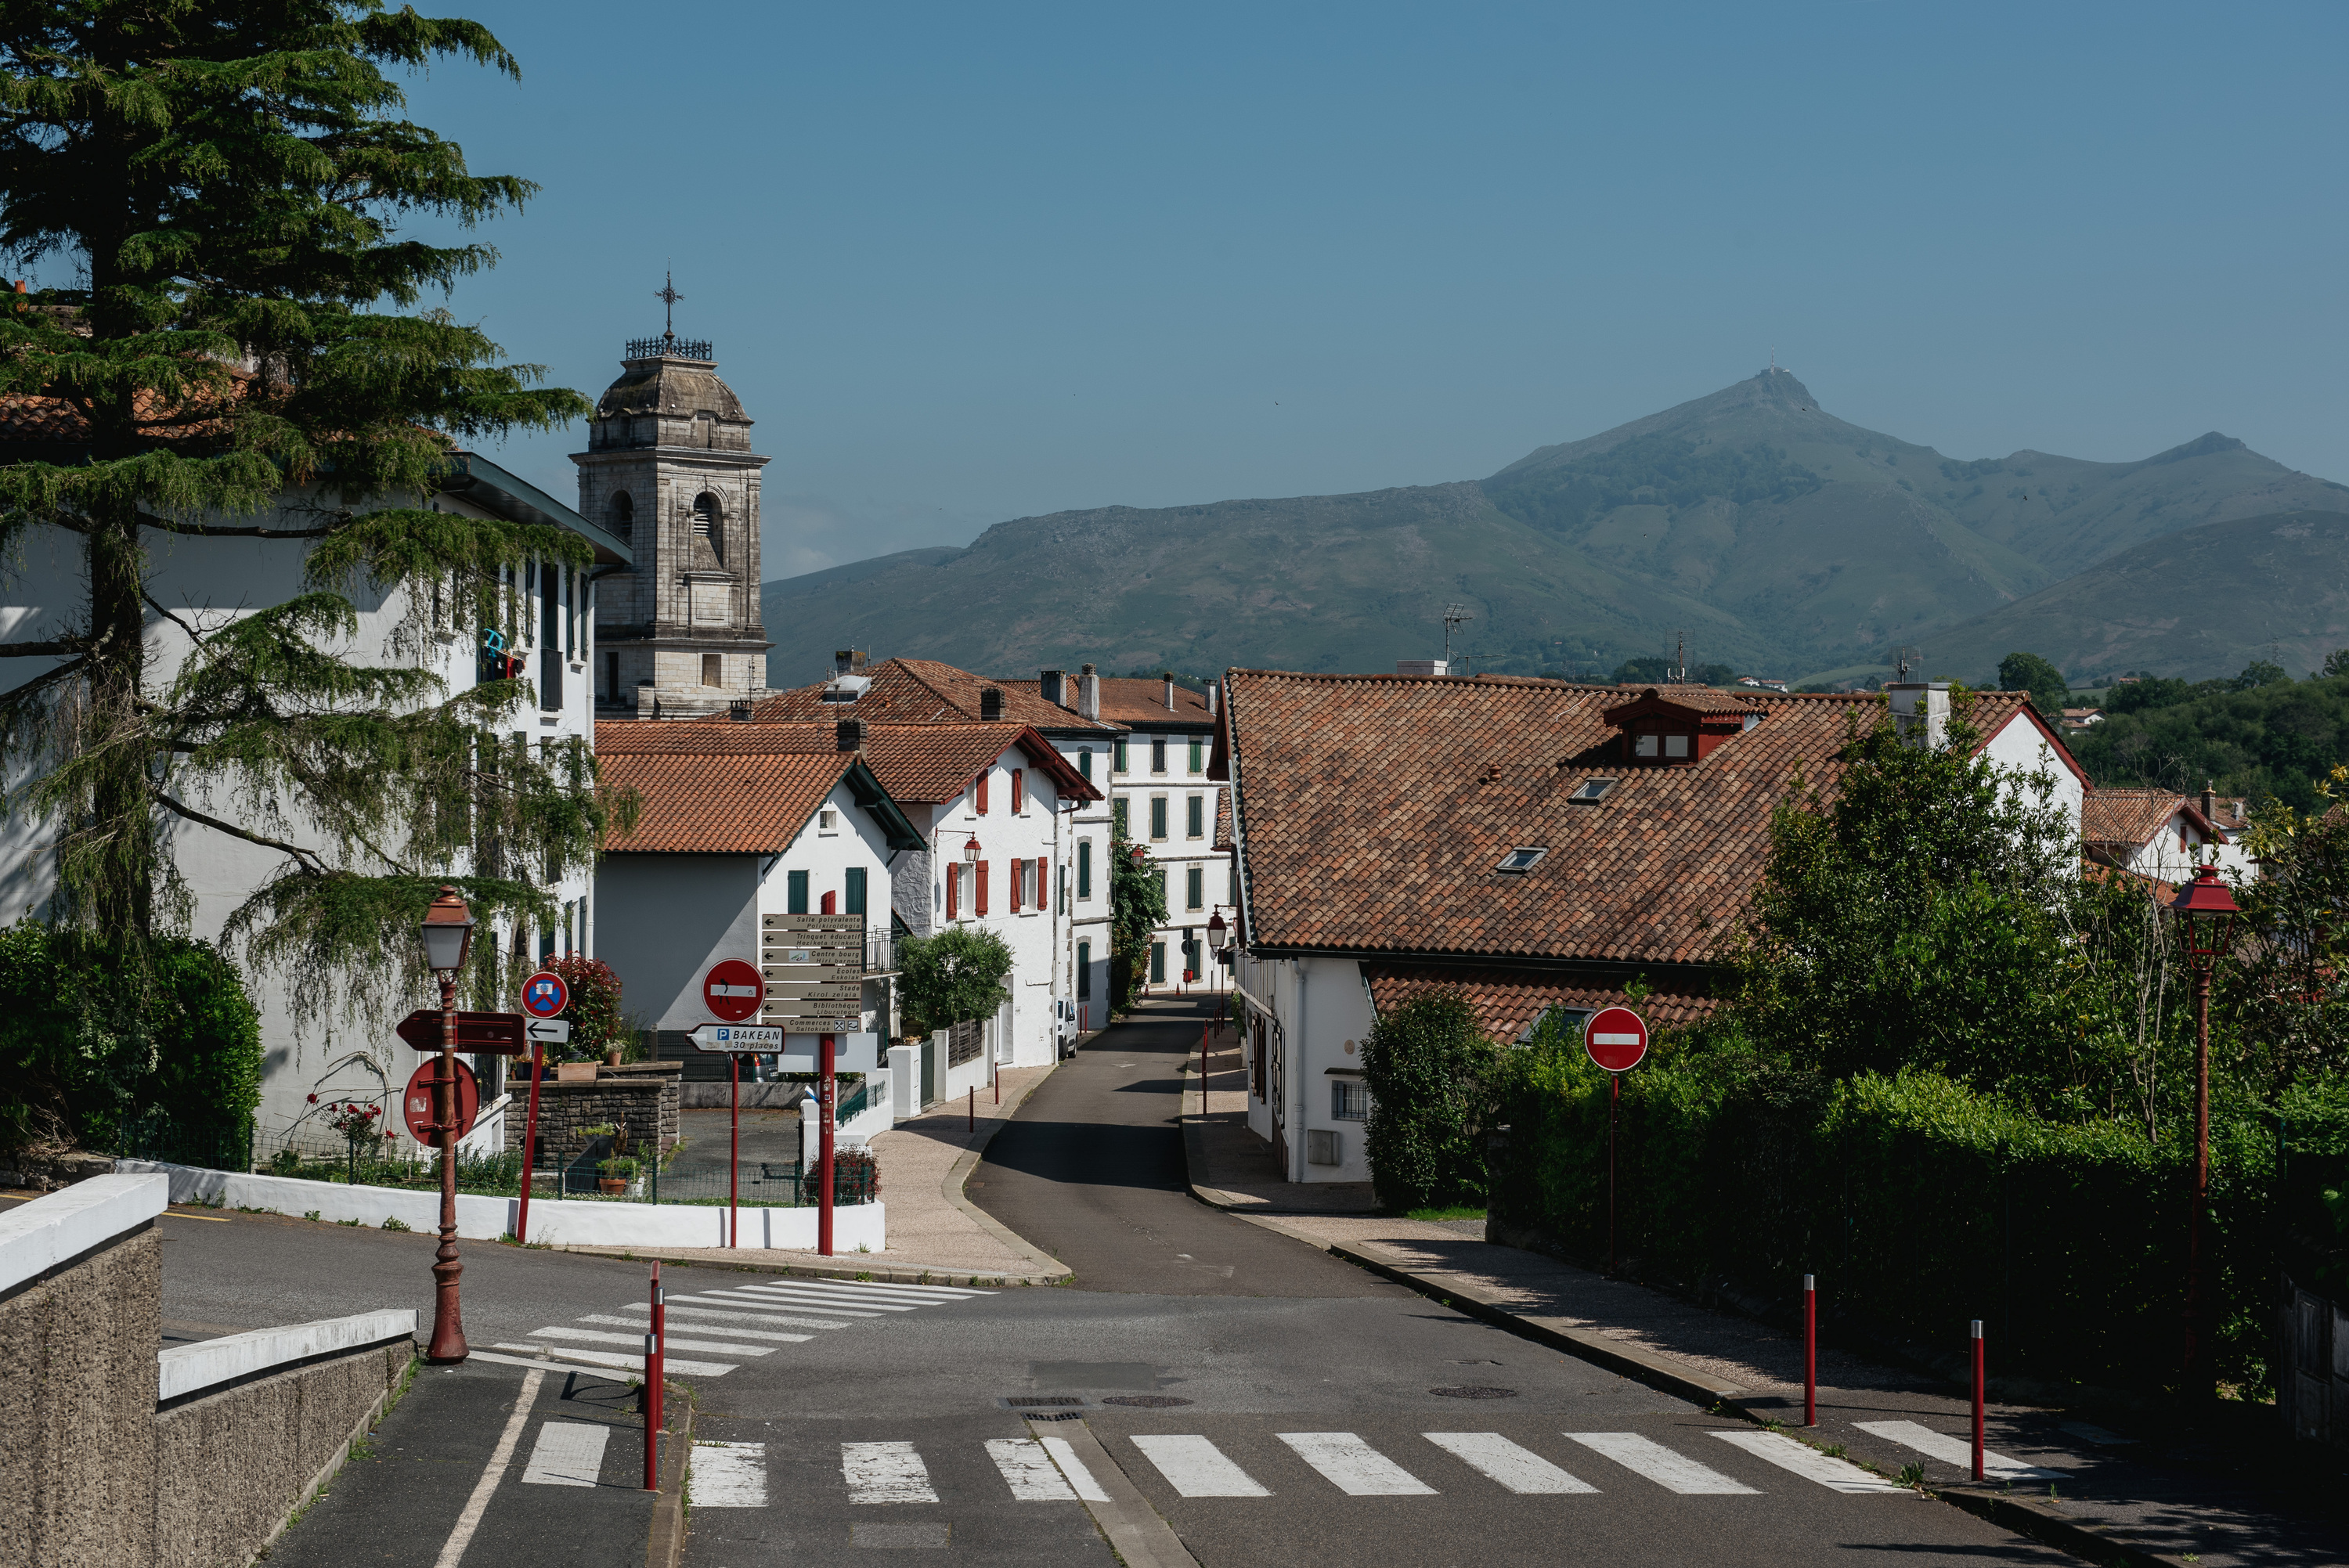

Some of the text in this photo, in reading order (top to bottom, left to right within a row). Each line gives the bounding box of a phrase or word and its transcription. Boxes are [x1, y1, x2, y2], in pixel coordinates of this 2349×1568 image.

[719, 1030, 780, 1040] P BAKEAN
[749, 1041, 778, 1050] places
